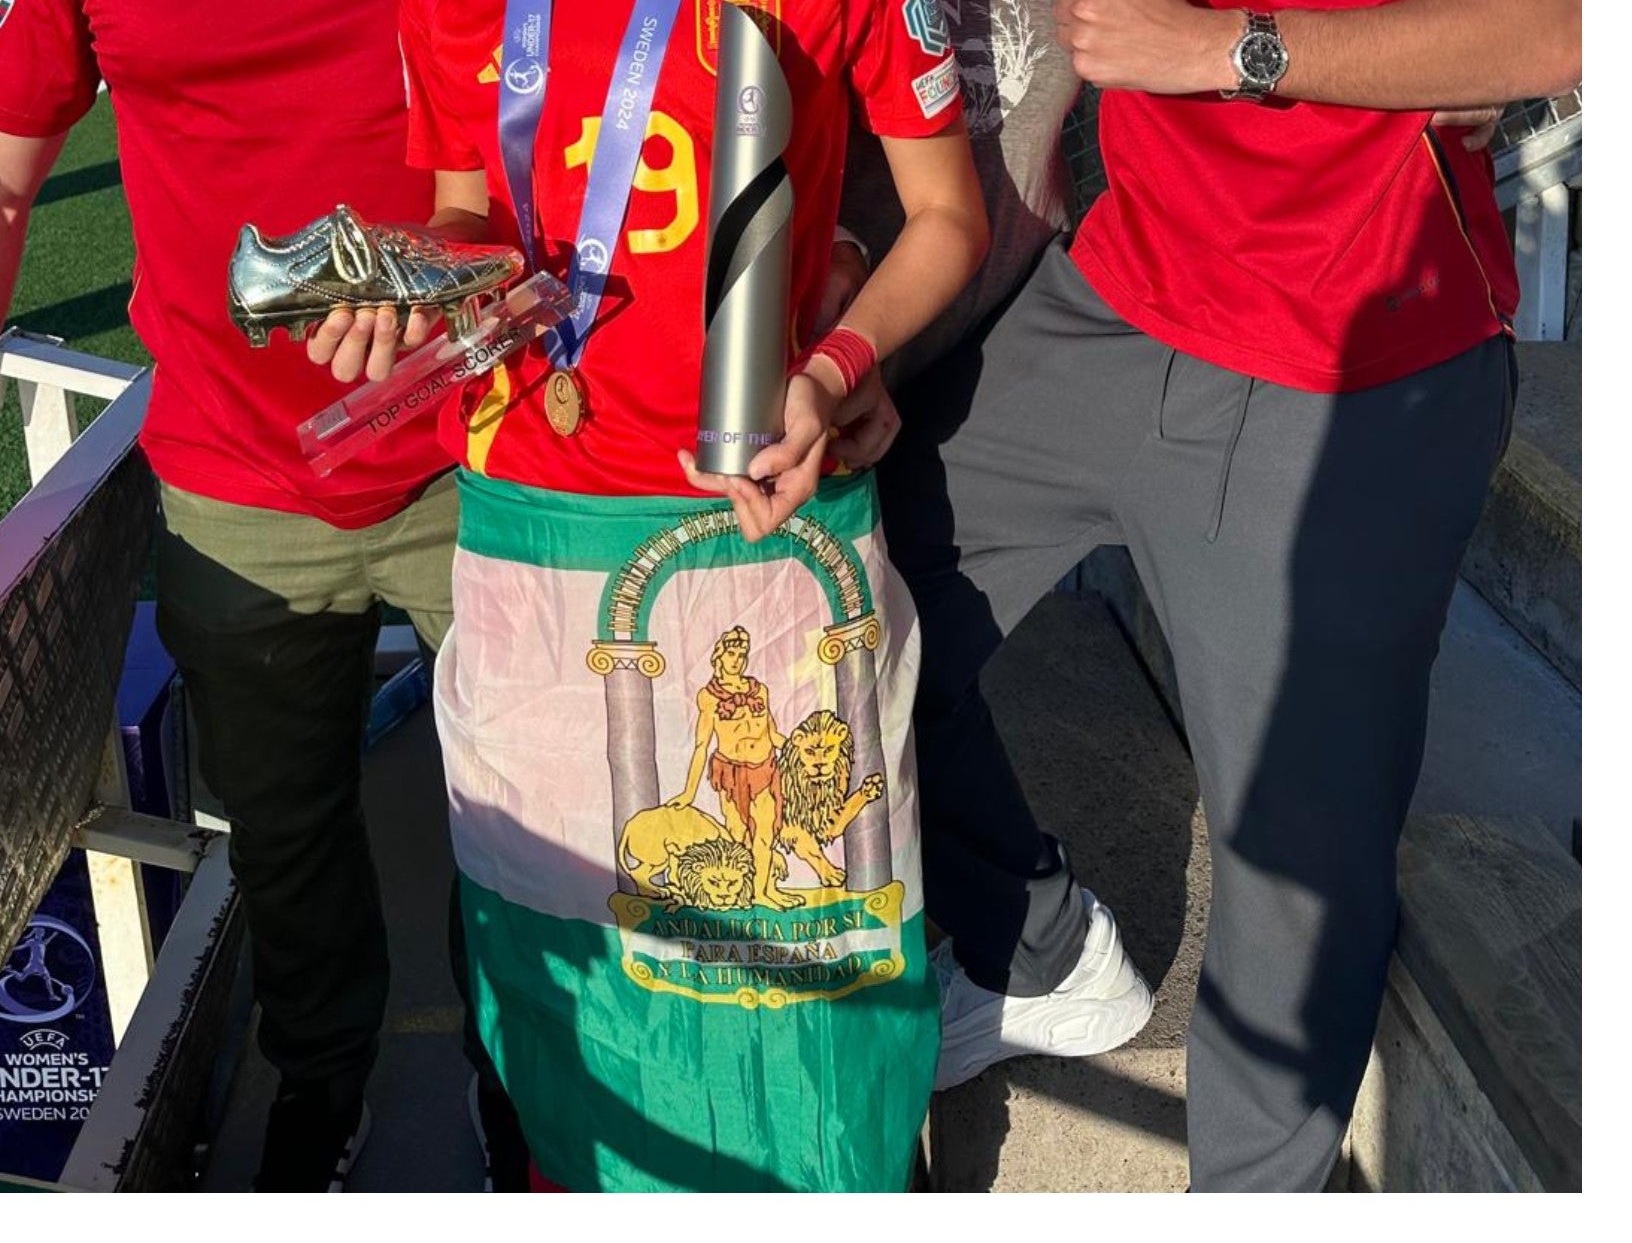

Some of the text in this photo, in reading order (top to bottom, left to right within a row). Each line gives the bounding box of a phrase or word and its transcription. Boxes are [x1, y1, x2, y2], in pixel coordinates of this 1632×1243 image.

[615, 16, 658, 131] SWEDEN 2024
[367, 326, 521, 434] TOP GOAL SCORER
[681, 939, 838, 964] PARA ESPAÑA
[680, 962, 708, 986] LA
[23, 1032, 65, 1047] UEFA
[4, 1053, 89, 1066] WOMEN'S
[70, 1107, 91, 1121] 20
